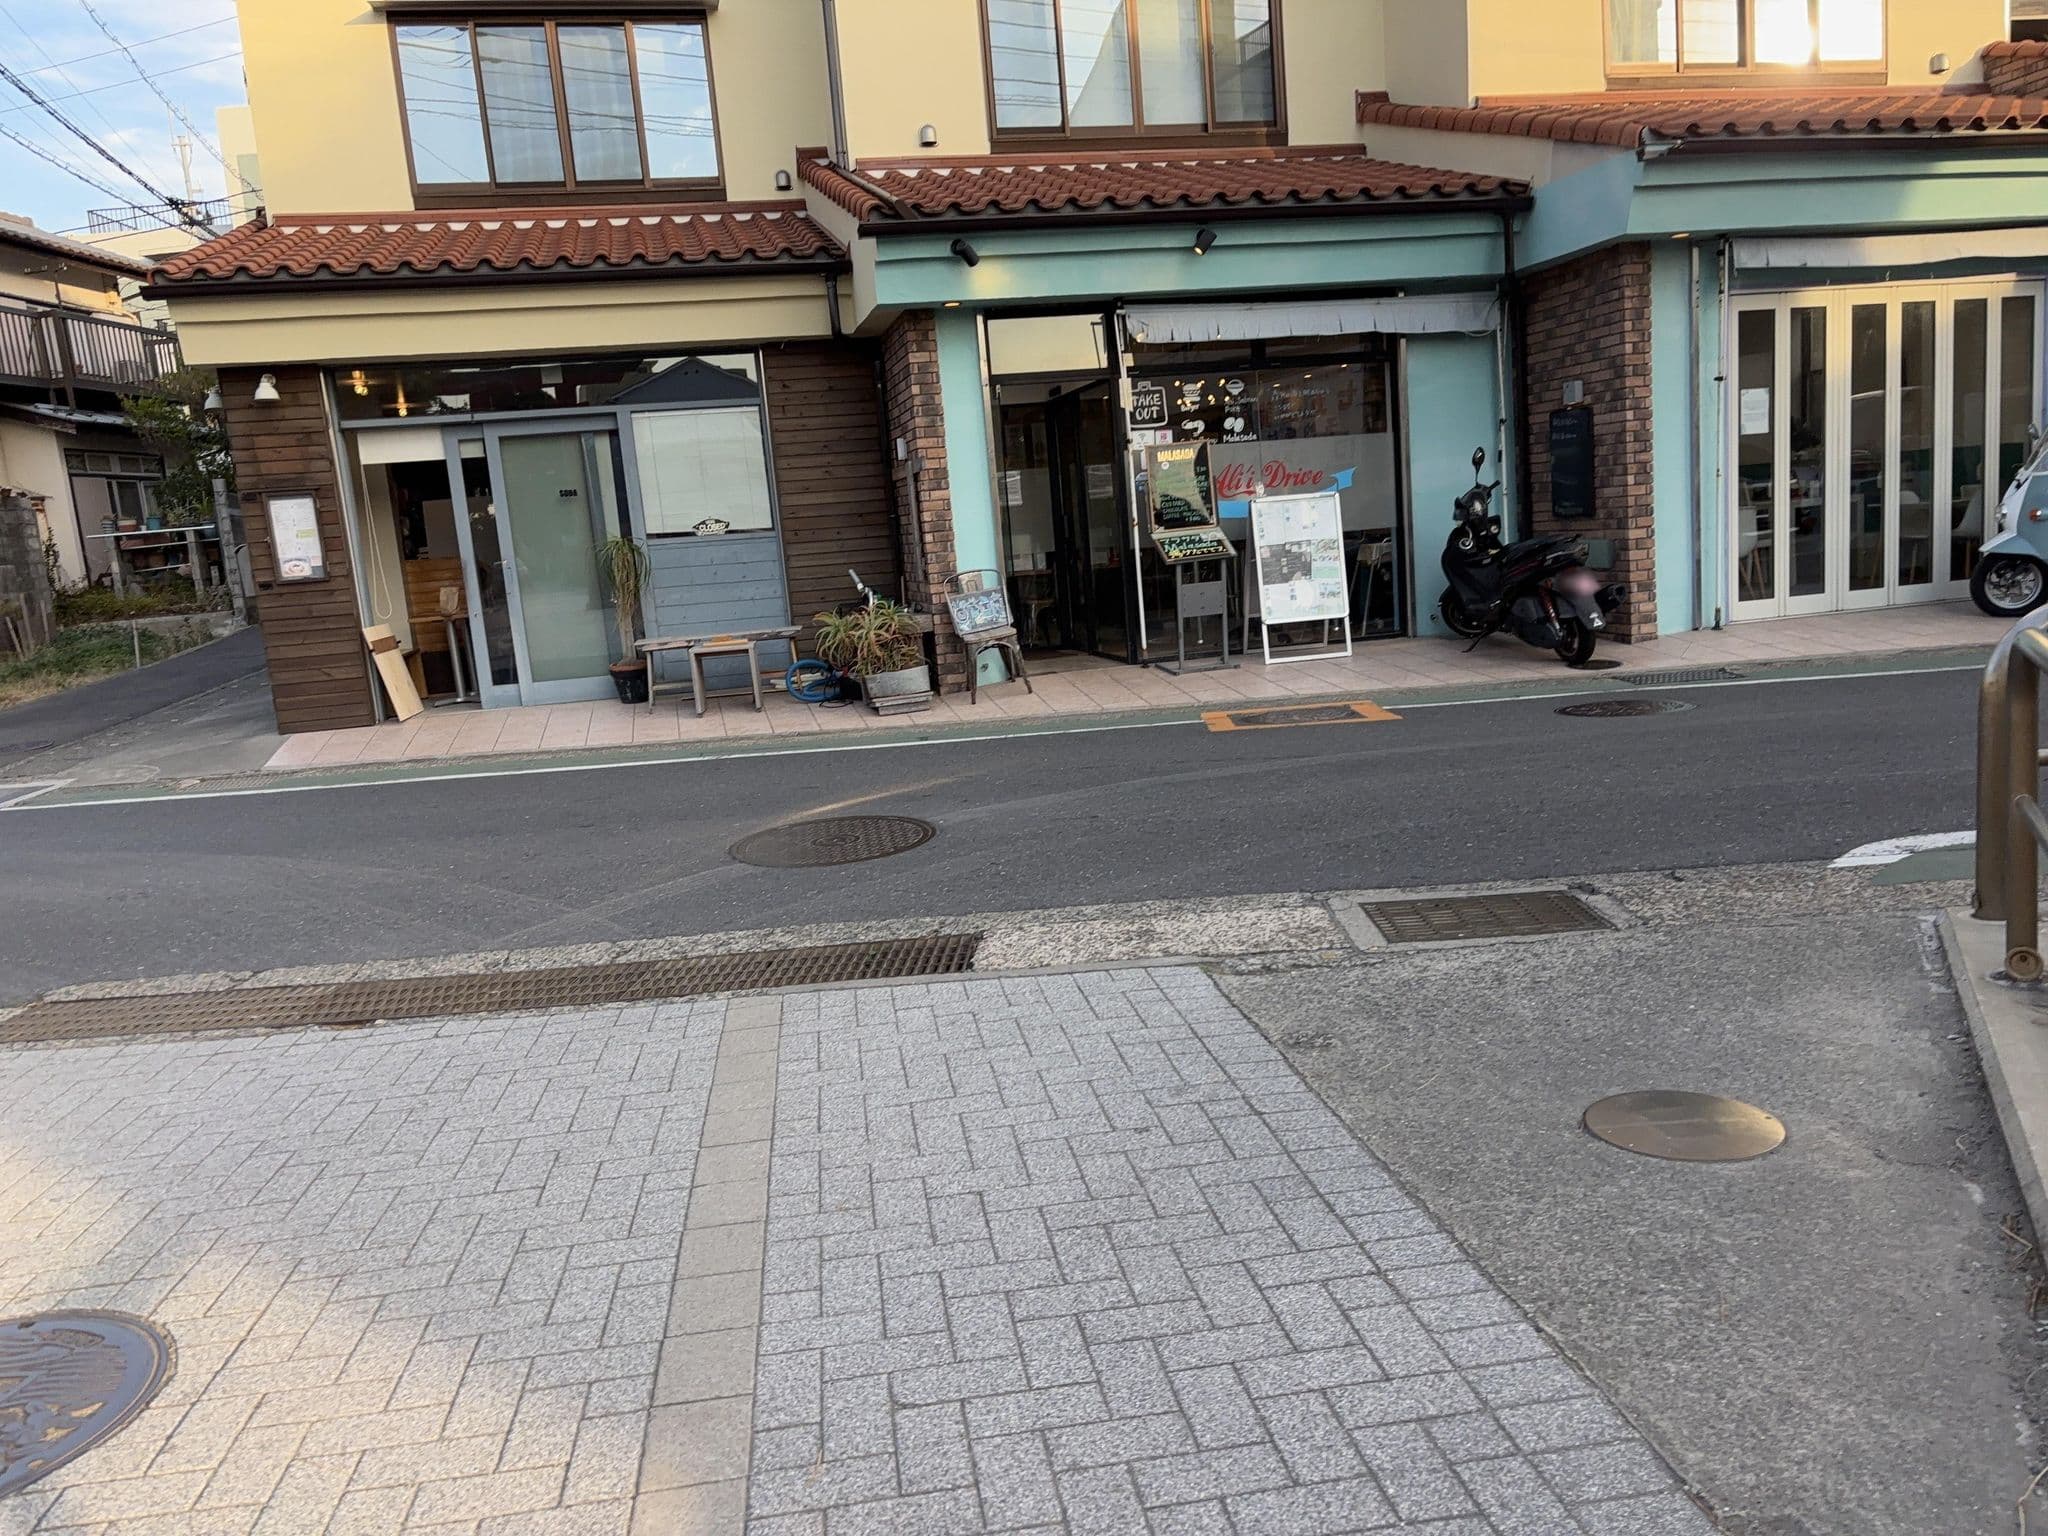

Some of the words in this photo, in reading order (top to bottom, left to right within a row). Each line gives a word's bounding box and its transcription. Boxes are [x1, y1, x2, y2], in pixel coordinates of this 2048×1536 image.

[1132, 393, 1161, 407] TAKE
[1135, 406, 1160, 420] OUT
[1264, 460, 1324, 489] Drive
[699, 523, 726, 532] CLOSED
